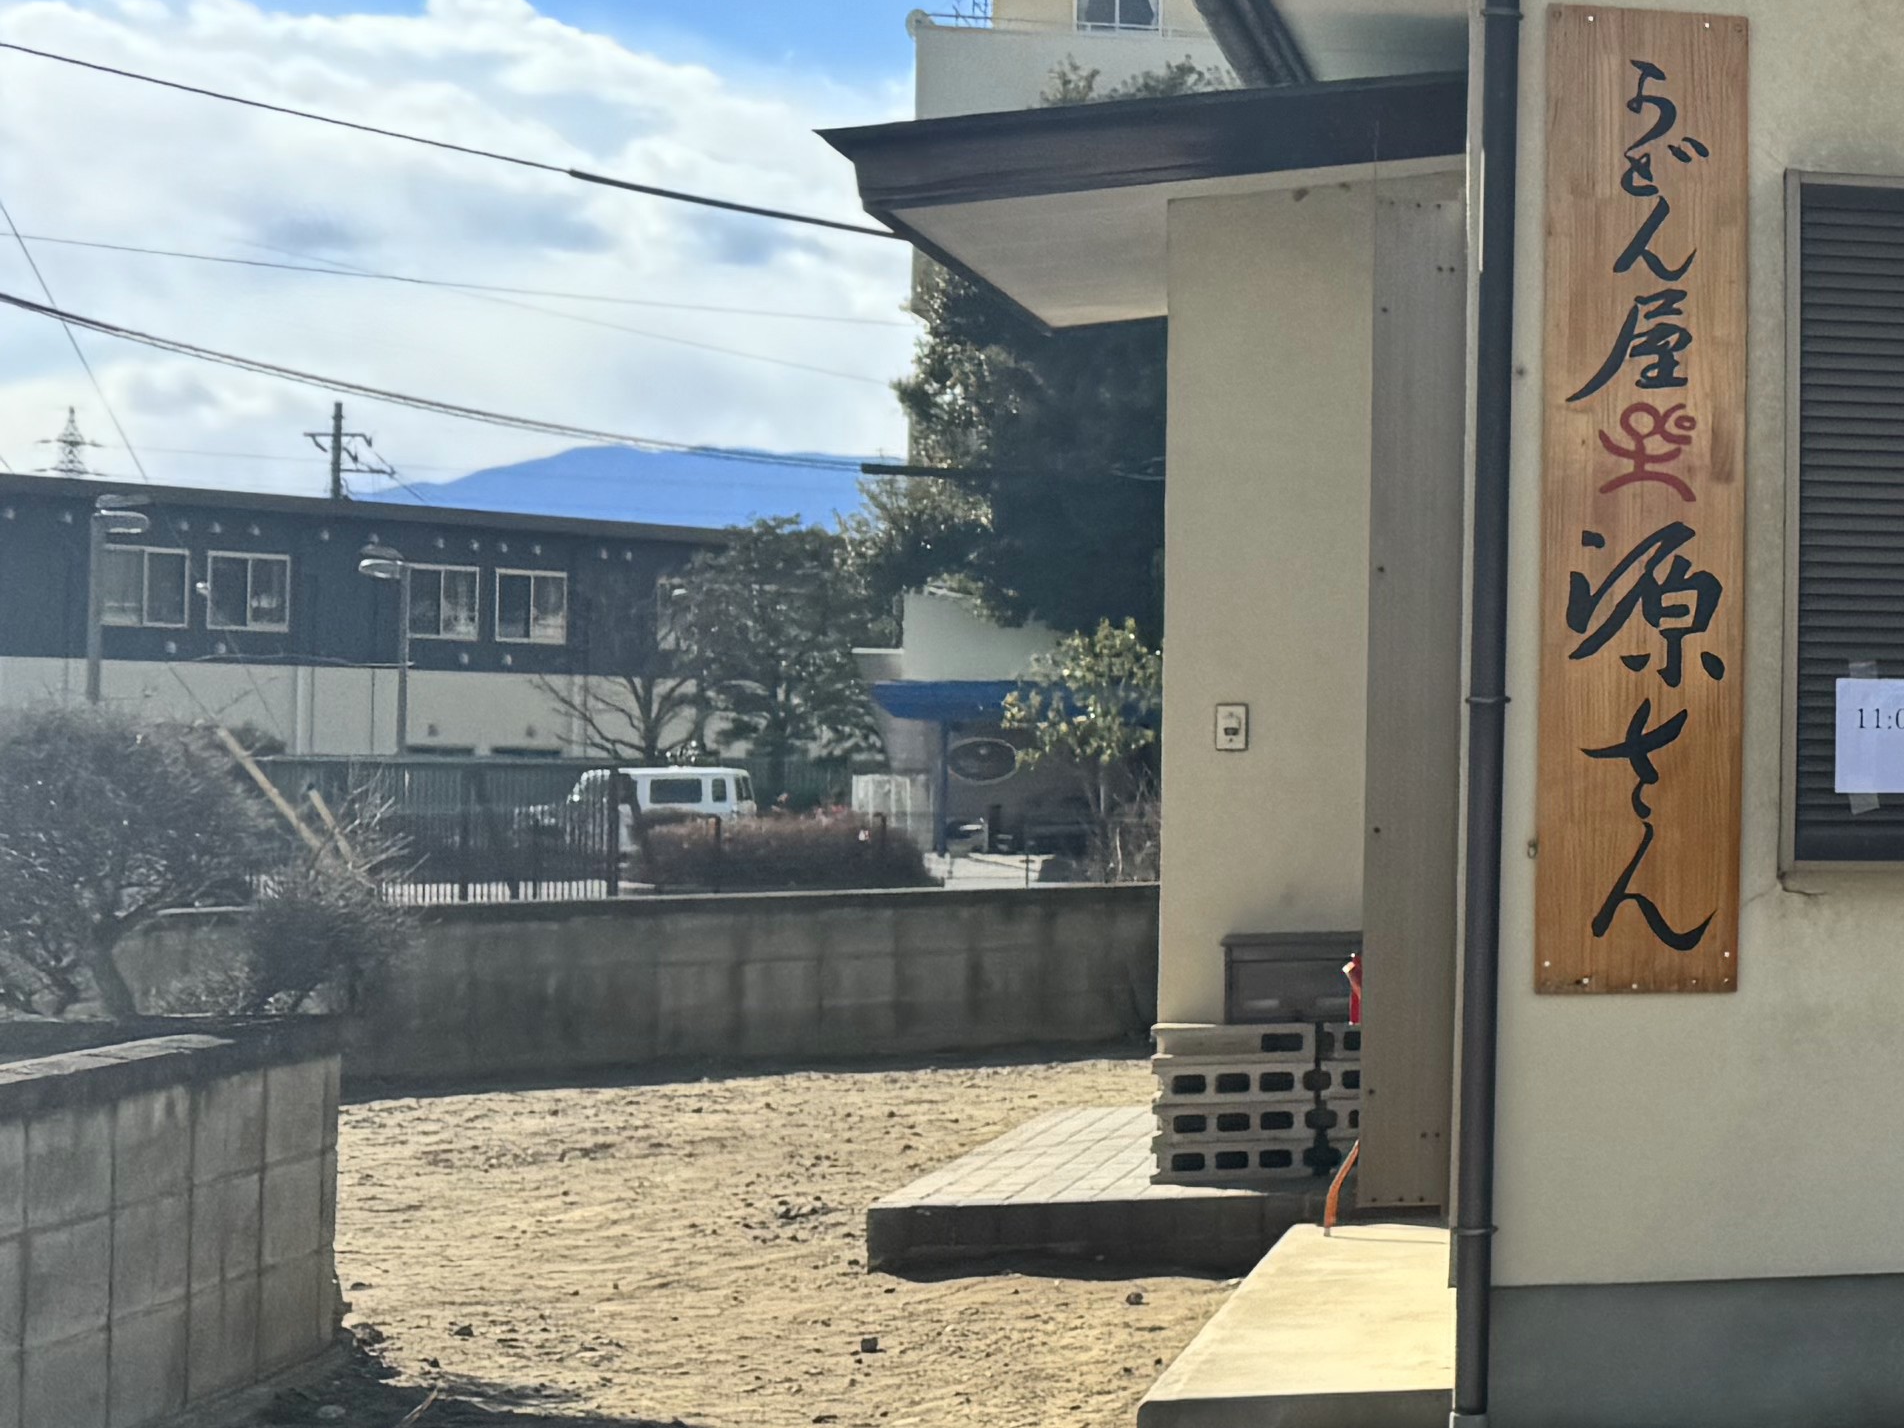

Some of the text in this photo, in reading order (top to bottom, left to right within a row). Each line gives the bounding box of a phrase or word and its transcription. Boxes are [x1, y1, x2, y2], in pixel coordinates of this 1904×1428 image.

[1566, 60, 1725, 951] うどん屋 源さん
